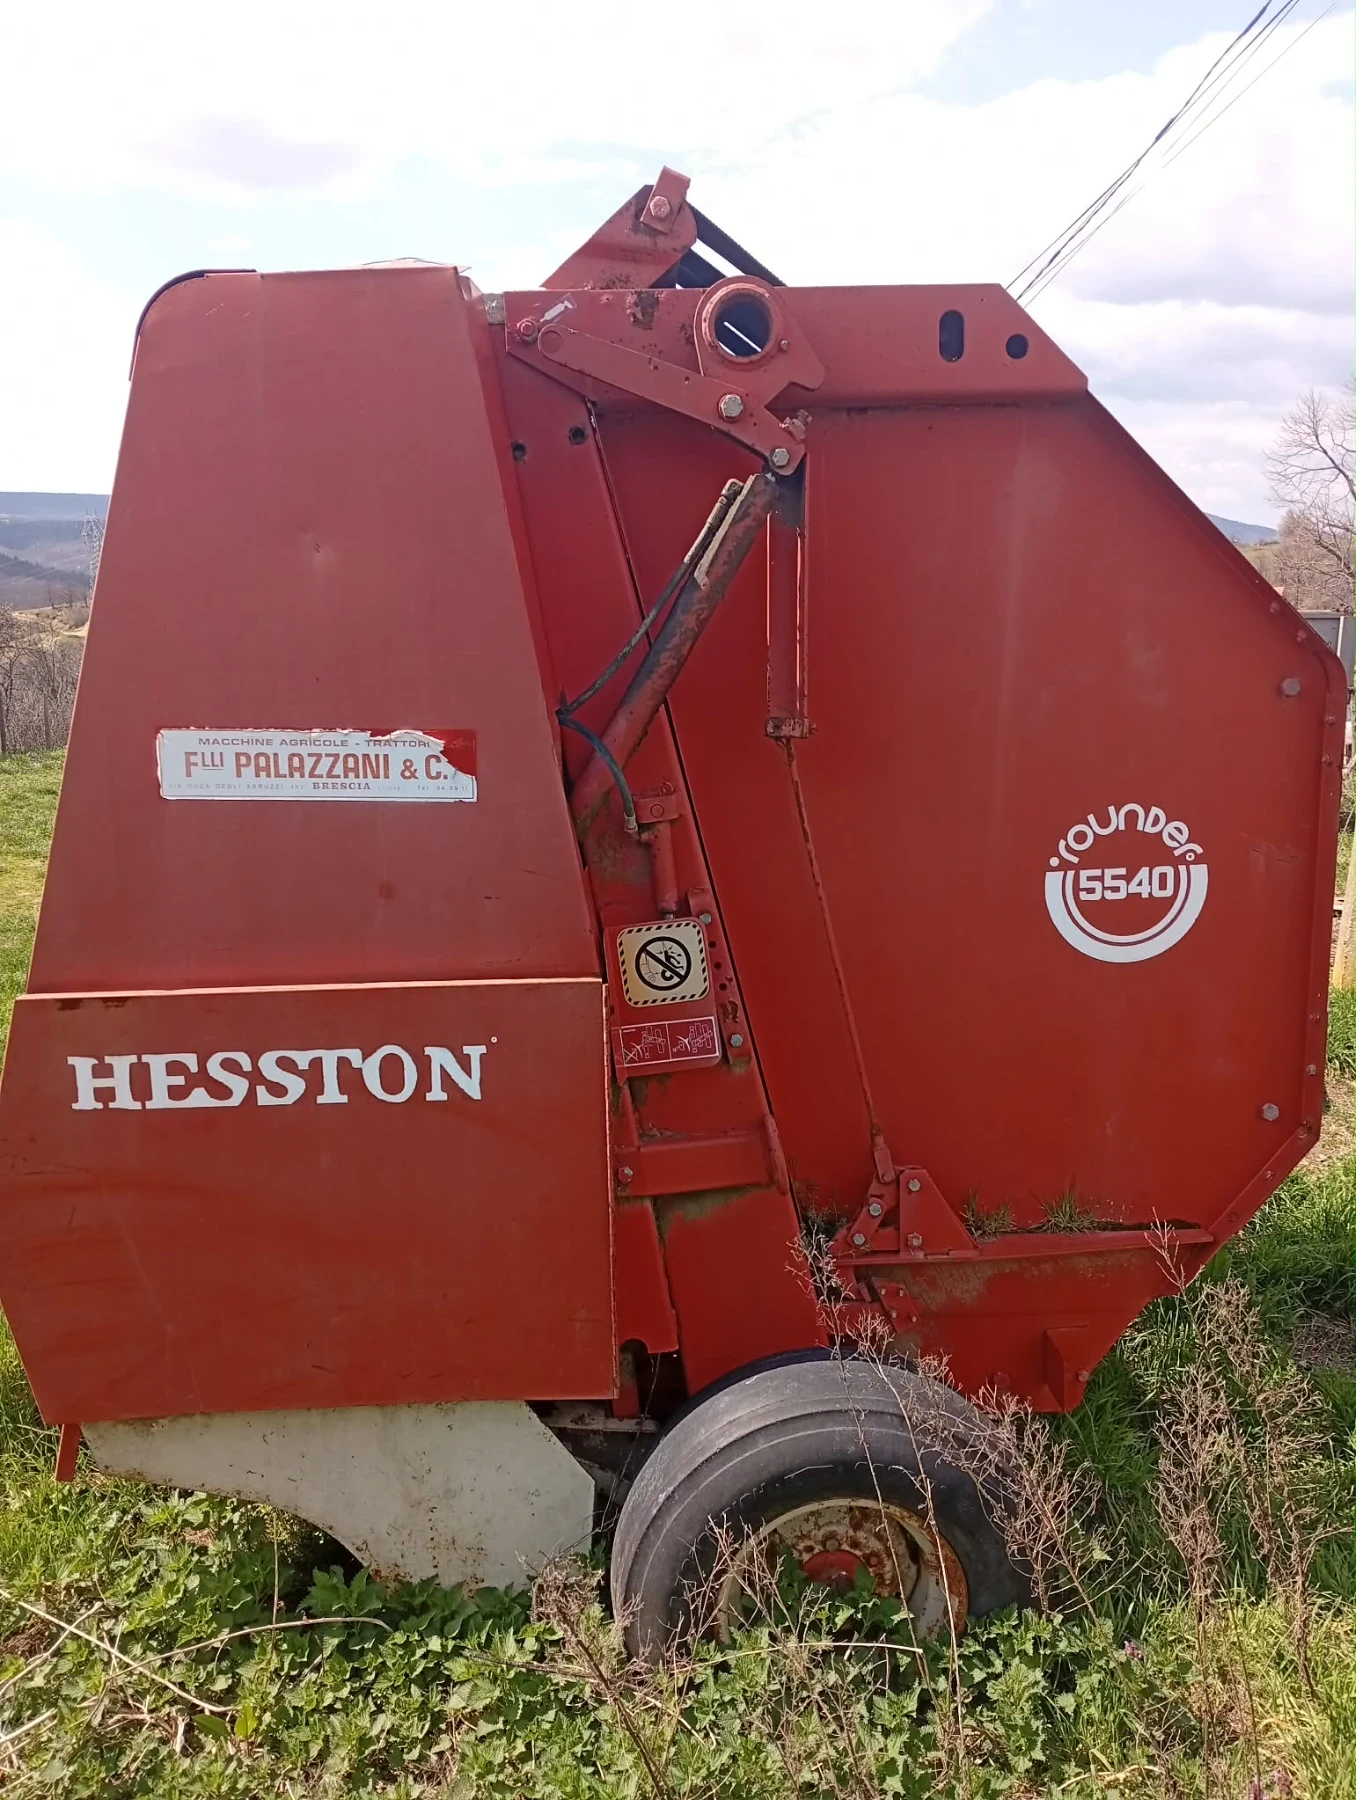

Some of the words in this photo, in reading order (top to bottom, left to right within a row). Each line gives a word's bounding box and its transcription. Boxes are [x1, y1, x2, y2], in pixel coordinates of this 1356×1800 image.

[198, 738, 274, 746] MACCHINE
[279, 739, 348, 747] AGRICOLE
[234, 752, 390, 779] PALAZZANI
[400, 758, 419, 780] &
[425, 754, 448, 780] C.
[312, 782, 372, 790] BRESCIA
[1079, 865, 1175, 901] 5540
[67, 1044, 487, 1110] HESSTON
